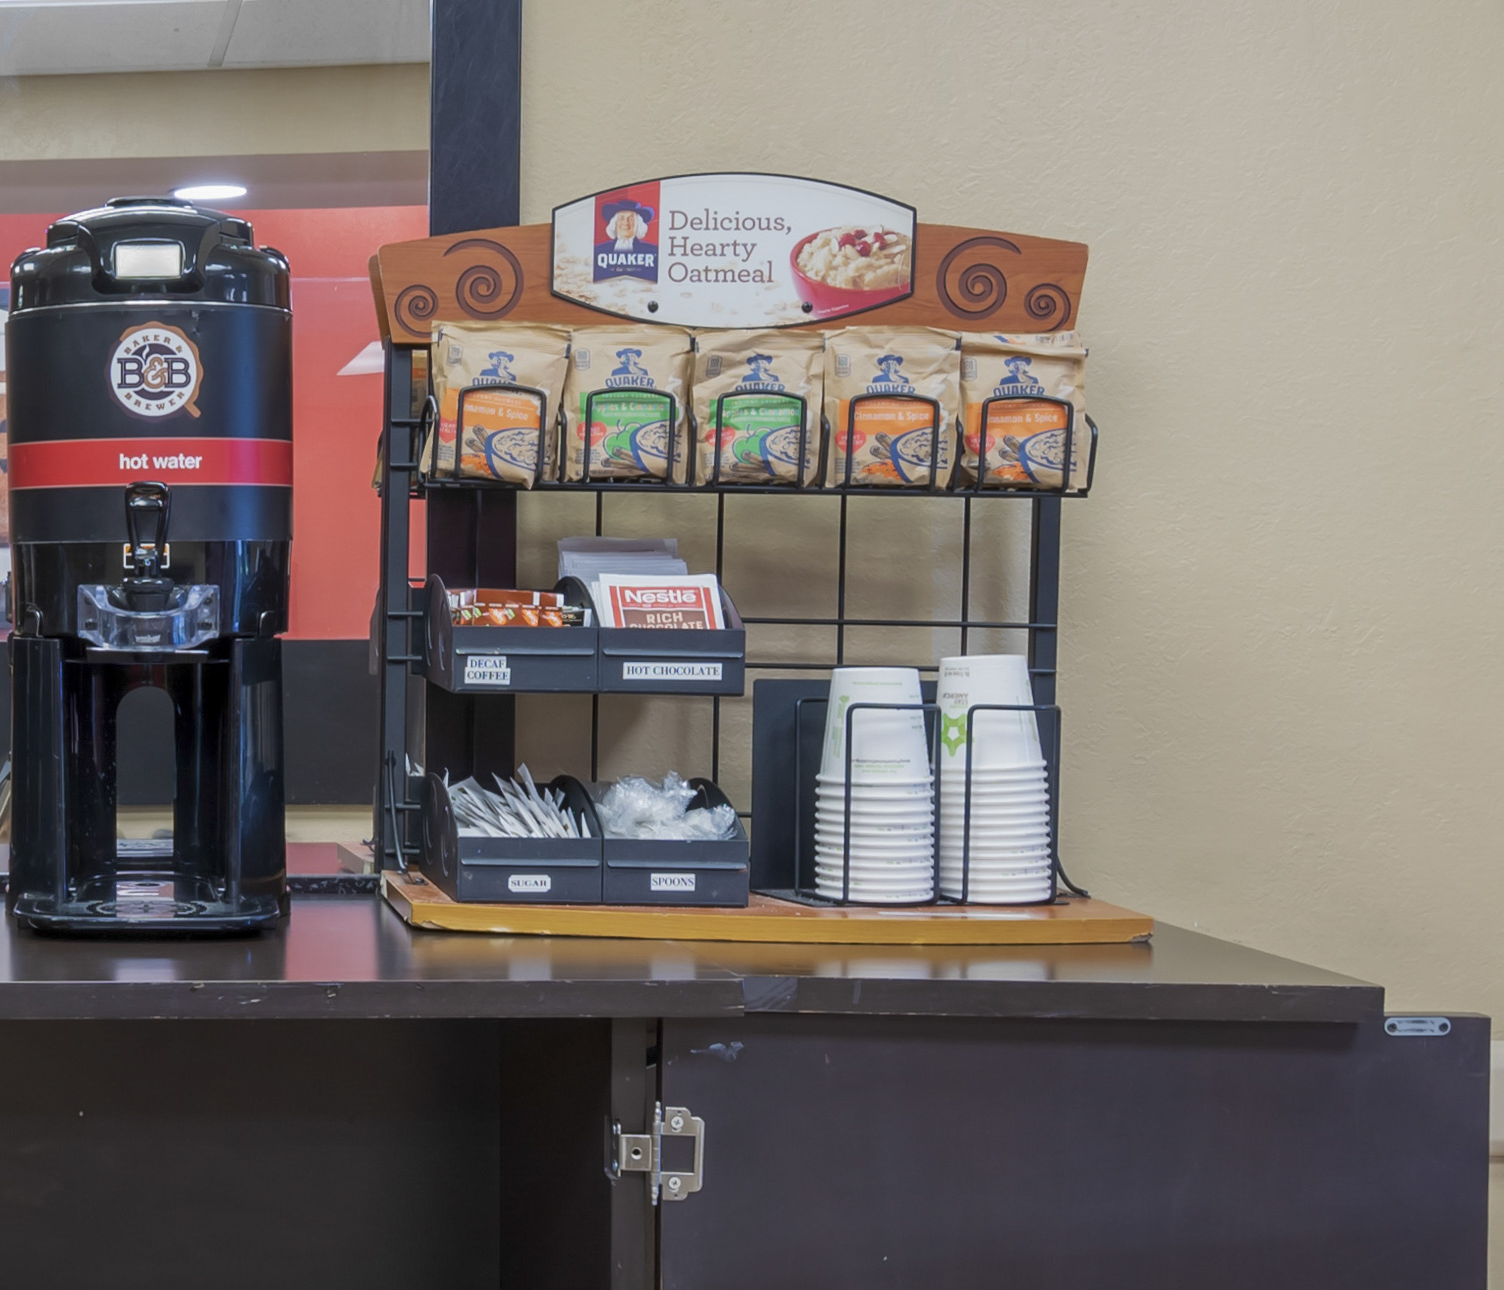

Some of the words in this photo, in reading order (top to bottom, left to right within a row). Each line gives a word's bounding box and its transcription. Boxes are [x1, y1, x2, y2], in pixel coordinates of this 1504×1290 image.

[667, 208, 793, 236] Delicious,
[667, 236, 757, 263] Hearty
[597, 252, 655, 268] QUAKER
[667, 260, 774, 284] Oatmeal
[124, 334, 172, 355] BAKER
[117, 355, 192, 390] B&B
[604, 376, 655, 389] QUAKER
[866, 383, 917, 395] QUAKER
[993, 385, 1045, 397] QUAKER
[124, 391, 185, 411] BREWER
[906, 411, 930, 422] Spice
[987, 414, 1023, 423] innamon
[1035, 412, 1058, 424] Spice
[119, 453, 149, 470] hot
[152, 453, 203, 470] water
[646, 612, 683, 624] RICH
[469, 658, 506, 668] DECAF
[466, 670, 509, 681] COFFEE
[626, 665, 651, 676] HOT
[653, 665, 720, 676] CHOCOLATE
[510, 880, 547, 888] SUGAR
[651, 876, 695, 887] SPOONS
